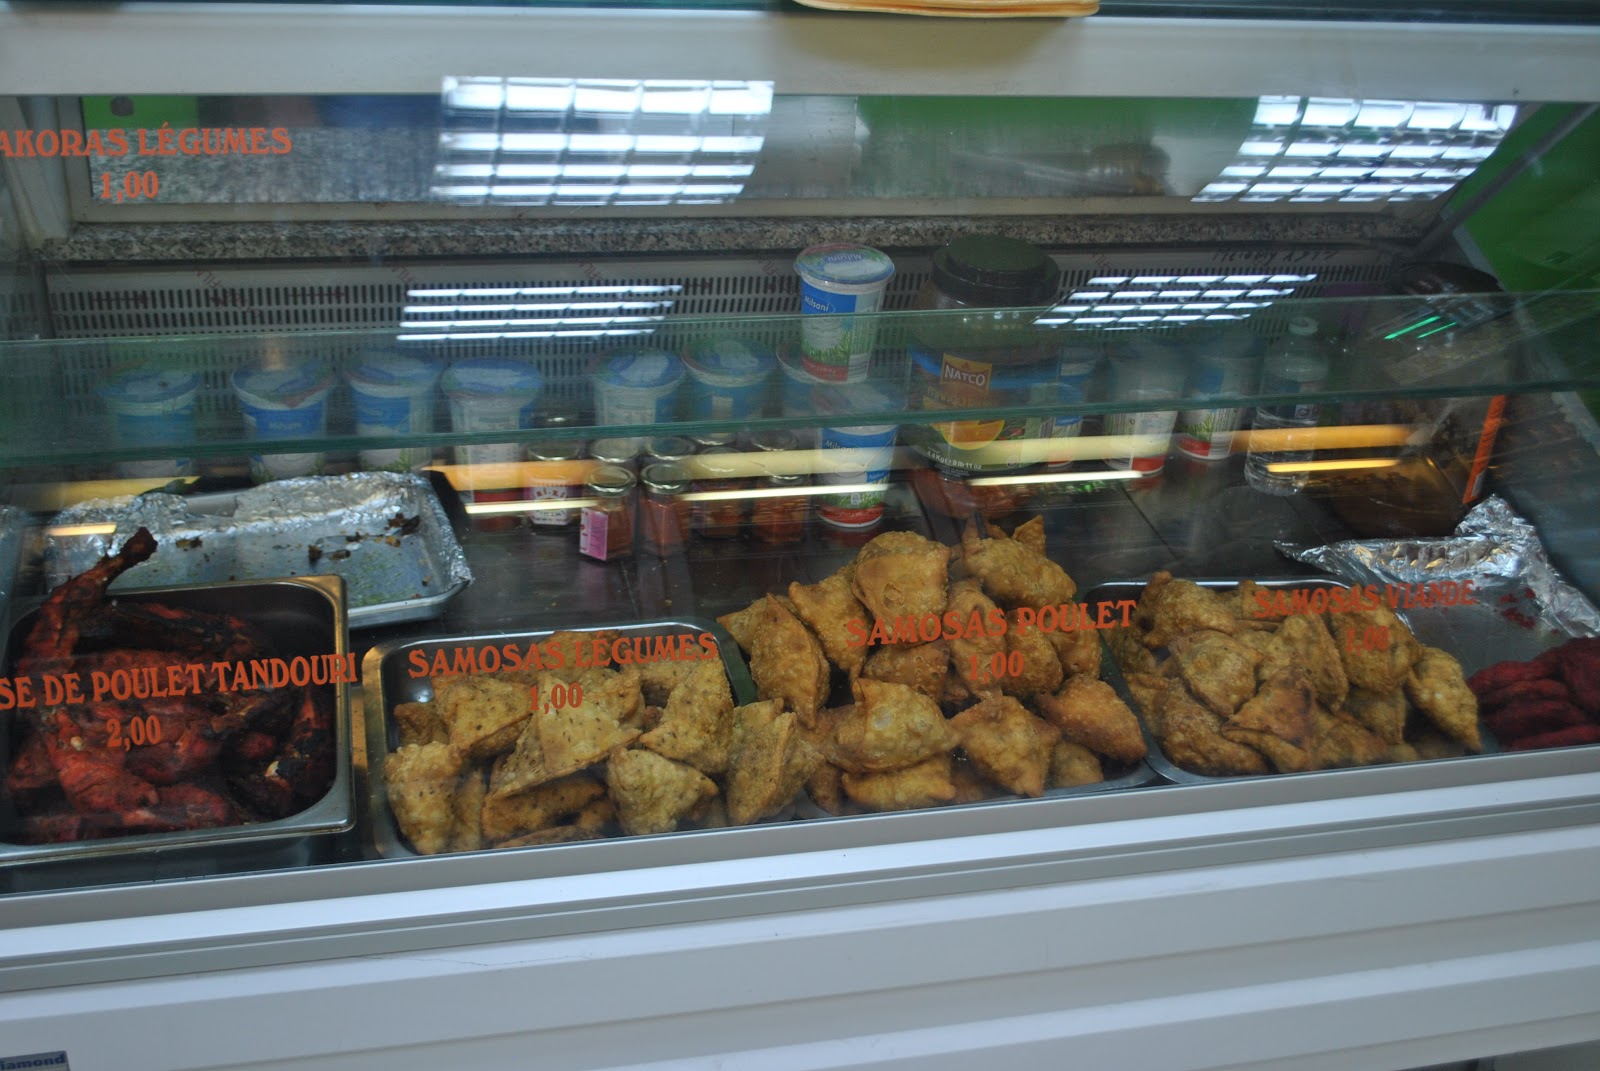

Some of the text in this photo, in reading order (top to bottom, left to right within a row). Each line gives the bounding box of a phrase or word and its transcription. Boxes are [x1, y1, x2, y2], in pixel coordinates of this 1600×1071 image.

[139, 122, 292, 155] LÉGUMES
[101, 171, 159, 202] 1,00
[804, 295, 830, 312] Milsani
[944, 364, 986, 386] NATCO
[1254, 580, 1476, 618] SAMOSAS VIANDE
[845, 599, 1137, 648] SAMOSAS POULET
[408, 631, 718, 679] SAMOSAS LÉGUMES
[967, 650, 1024, 684] 1,00
[44, 673, 84, 706] DE
[92, 663, 206, 701] POULET
[212, 653, 357, 692] TANDOURI
[530, 682, 583, 714] 1,00
[106, 715, 162, 750] 2,00
